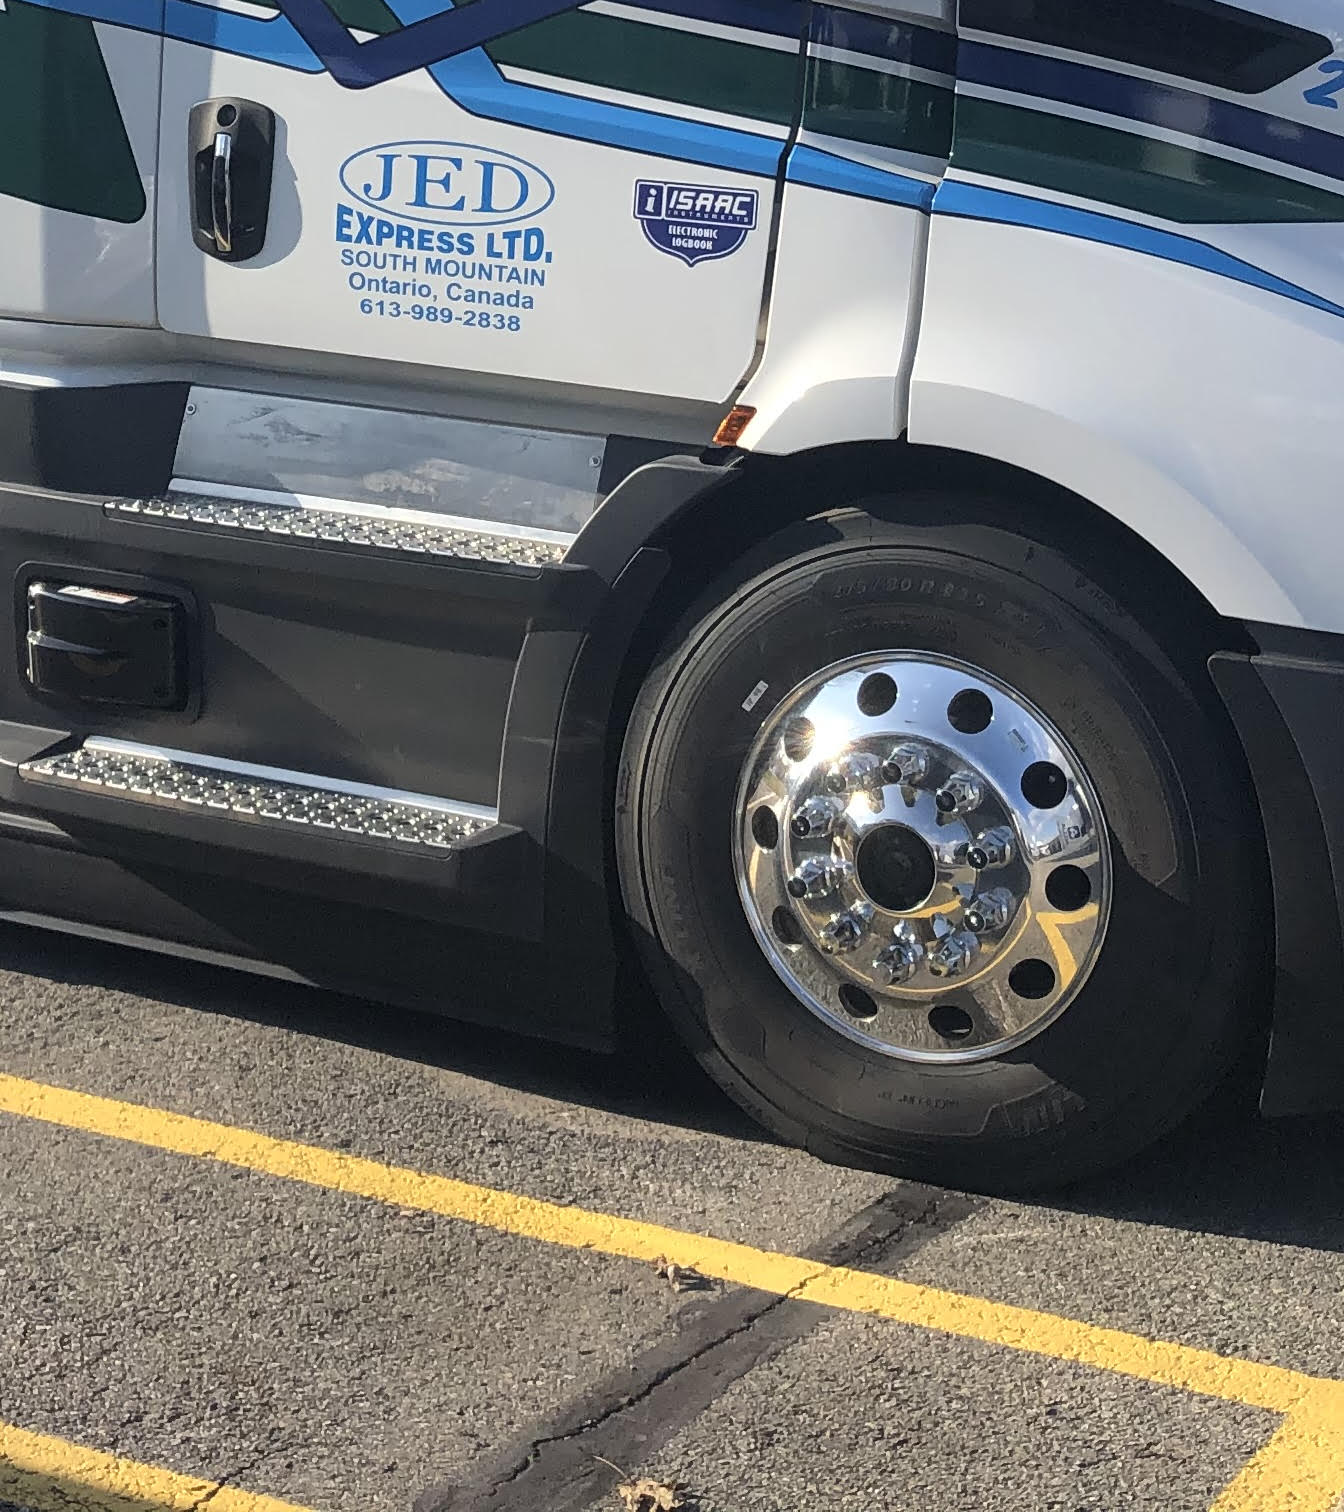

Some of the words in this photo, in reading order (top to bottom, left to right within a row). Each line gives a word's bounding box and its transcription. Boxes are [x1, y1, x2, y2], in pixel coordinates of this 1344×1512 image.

[363, 153, 529, 214] JED
[668, 190, 751, 216] ISAAC
[335, 203, 475, 256] EXPRESS
[486, 226, 553, 264] LTD.
[668, 225, 719, 240] ELECTRONIC
[672, 237, 713, 251] LOGBOOK
[340, 248, 417, 273] SOUTH
[424, 257, 546, 287] MOUNTAIN
[348, 271, 438, 302] Ontario,
[446, 282, 534, 310] Canada
[359, 298, 521, 332] 613-989-2838
